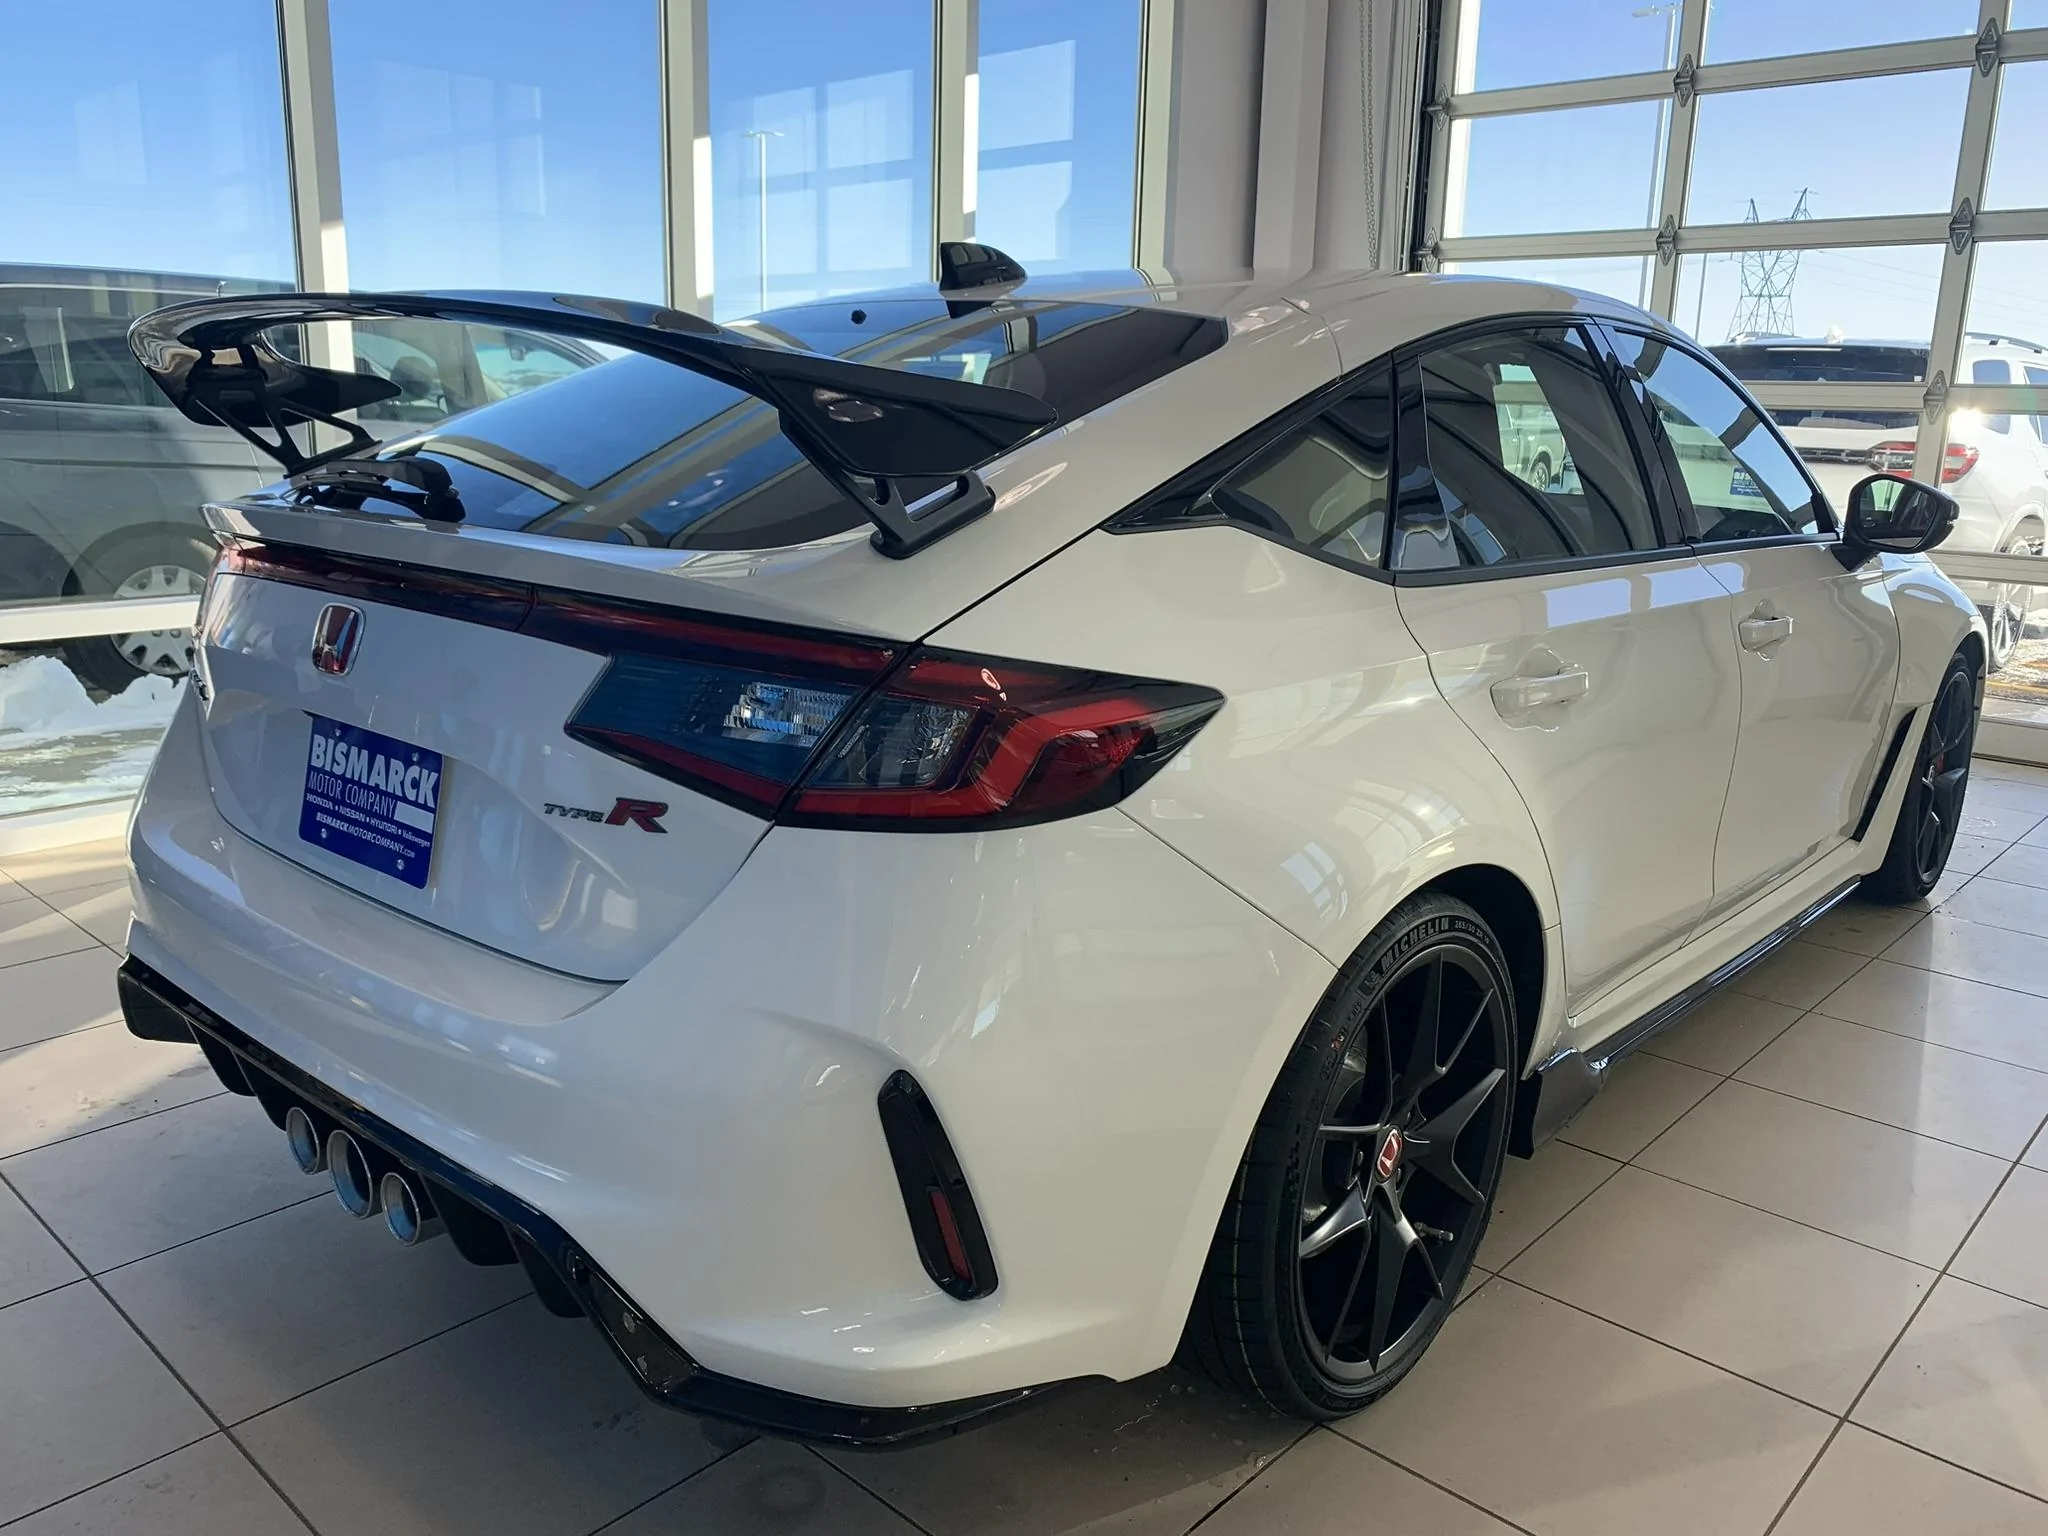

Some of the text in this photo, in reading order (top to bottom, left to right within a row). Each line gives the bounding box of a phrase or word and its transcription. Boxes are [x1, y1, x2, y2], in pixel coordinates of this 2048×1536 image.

[308, 770, 396, 819] MOTOR COMPANY
[310, 733, 439, 809] BISMARCK
[306, 792, 431, 848] HONDA NISSAN HYUNDAI Volkswagen
[543, 797, 669, 834] TYPE R
[1381, 917, 1450, 971] MICHELIN
